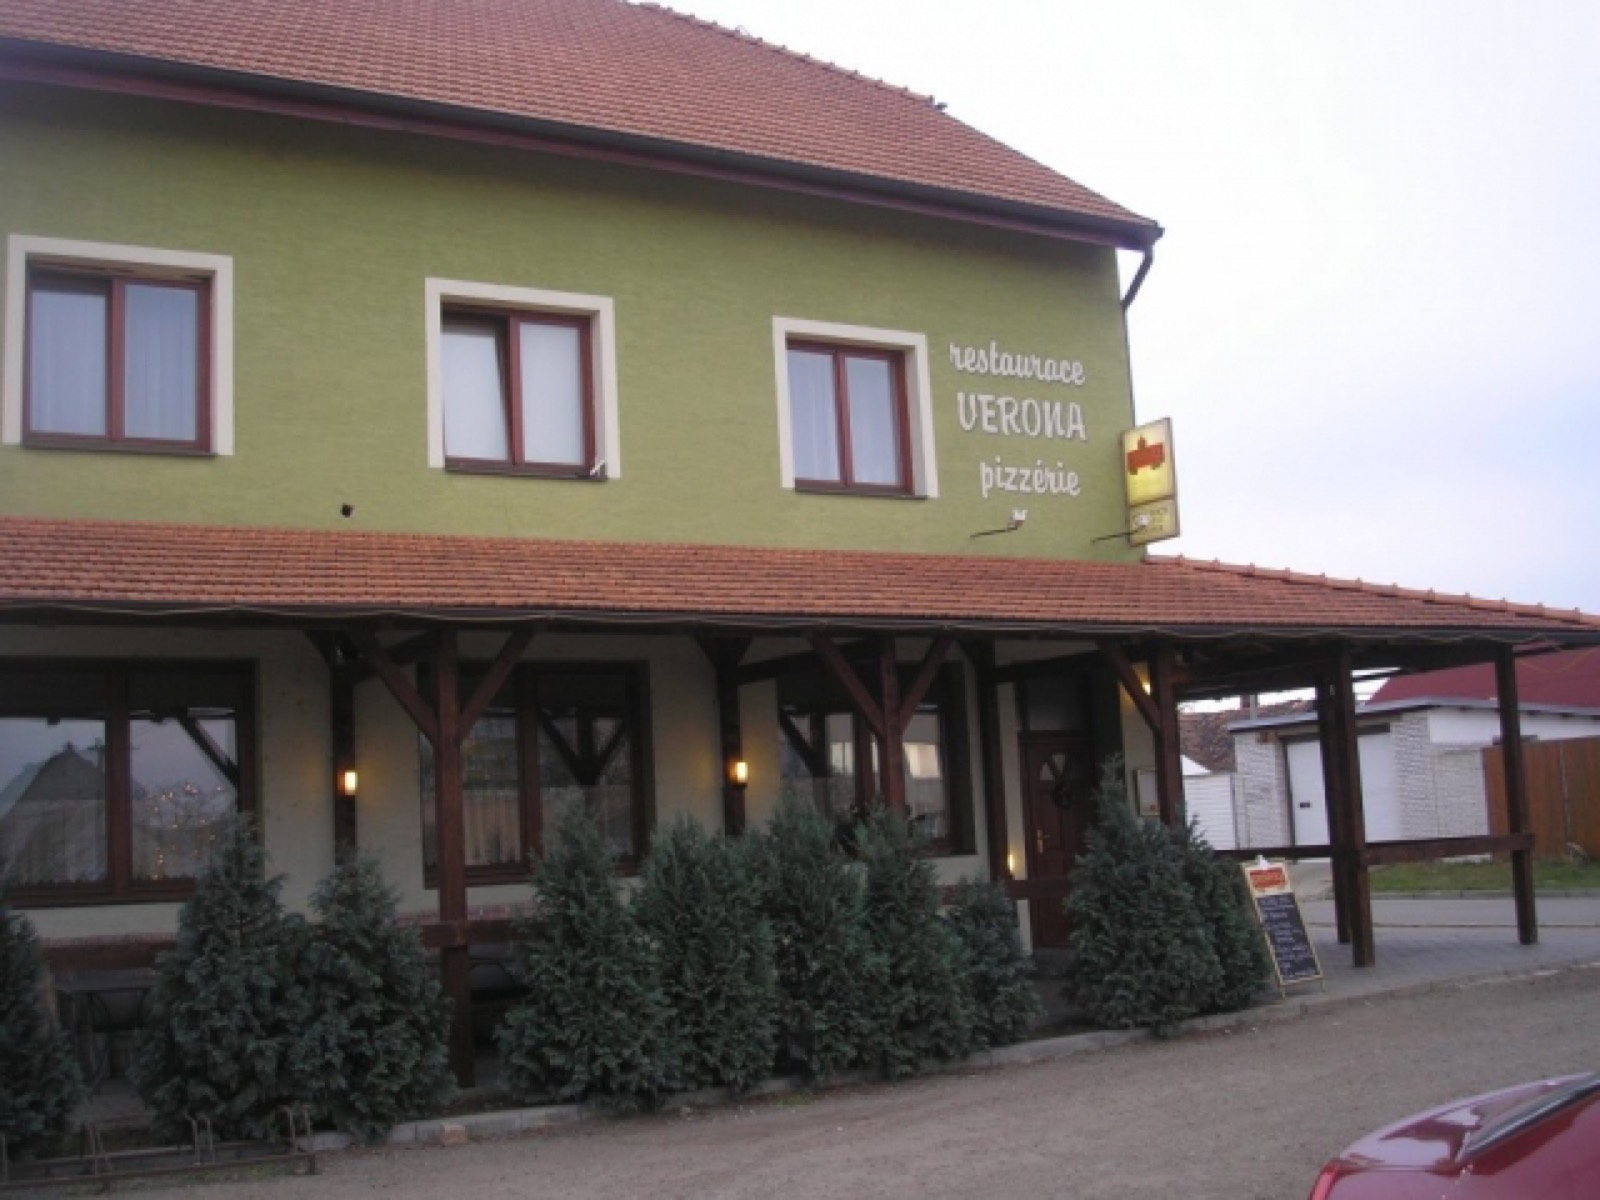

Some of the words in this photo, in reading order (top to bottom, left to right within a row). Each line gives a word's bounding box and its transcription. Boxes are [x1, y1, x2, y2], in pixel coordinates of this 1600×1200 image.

[949, 341, 1086, 385] restaurace
[957, 392, 1087, 440] VERONA
[979, 457, 1081, 498] pizzérie
